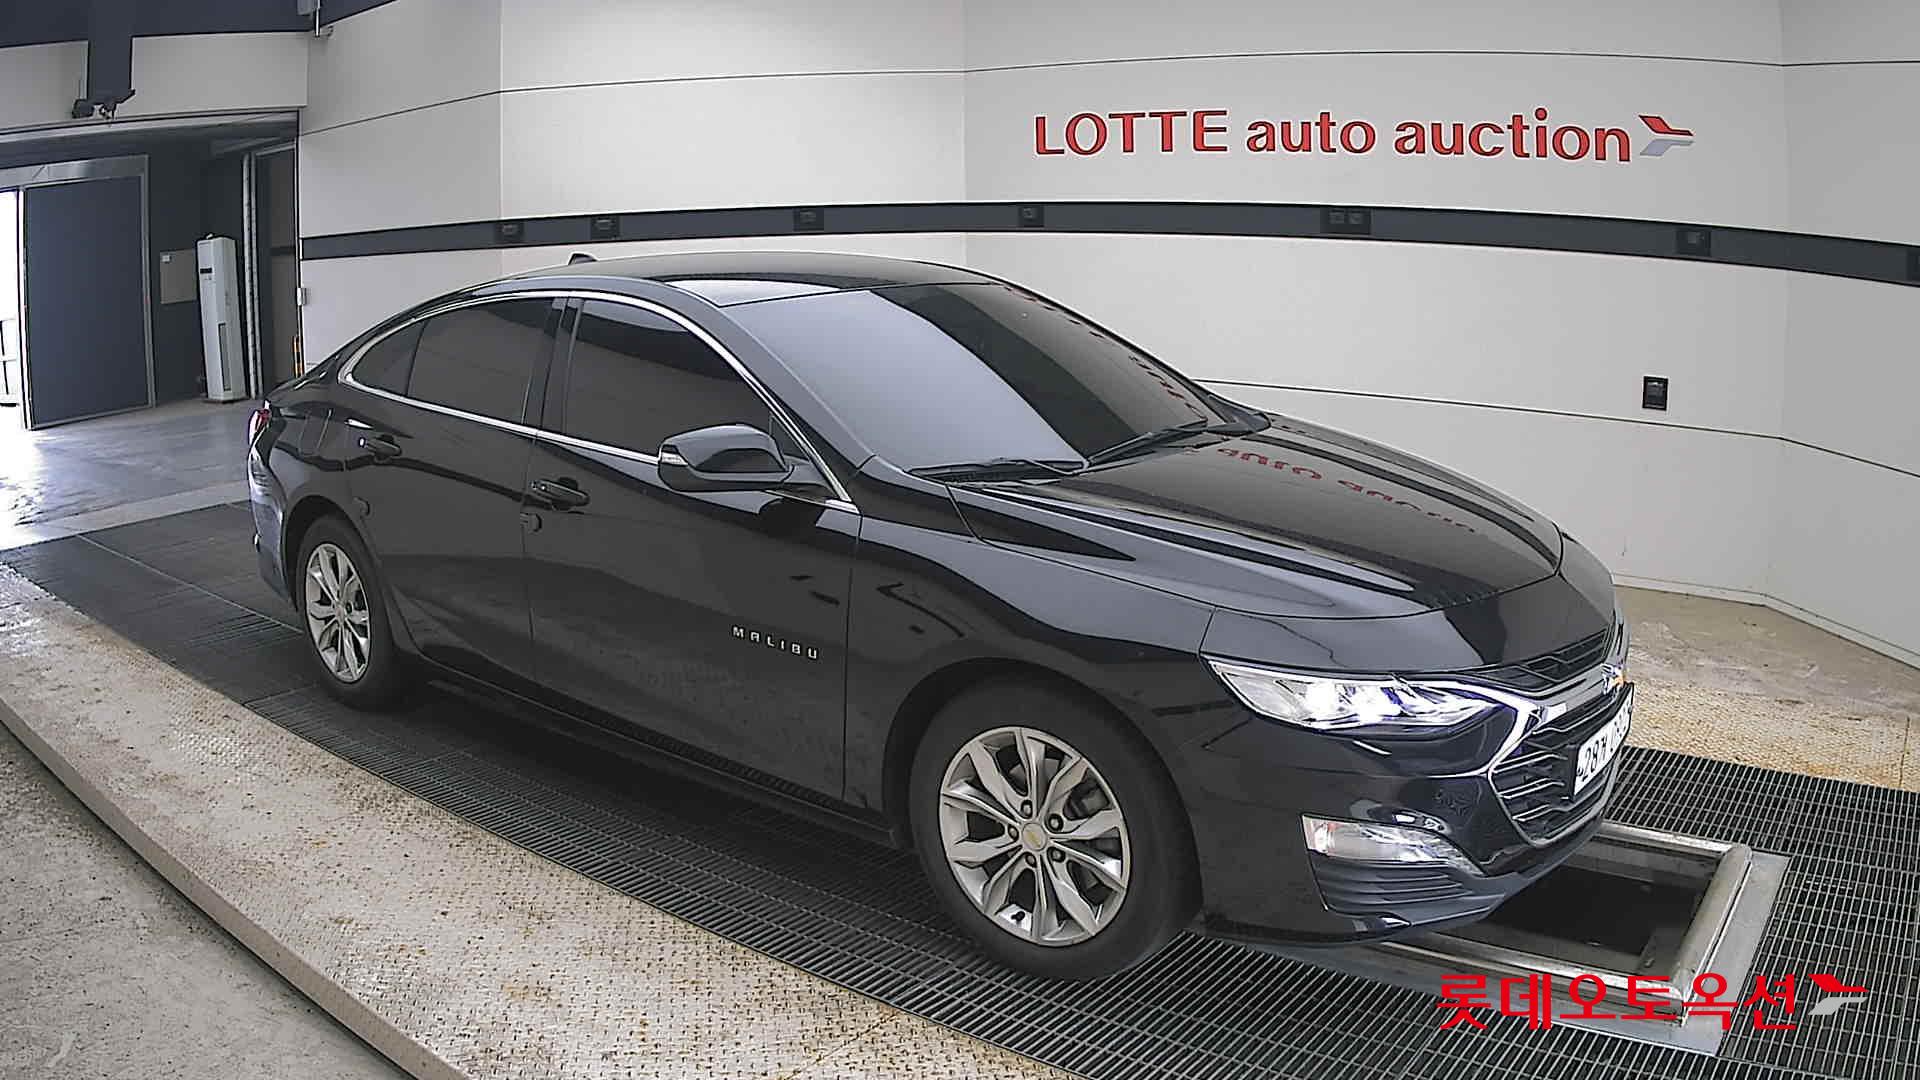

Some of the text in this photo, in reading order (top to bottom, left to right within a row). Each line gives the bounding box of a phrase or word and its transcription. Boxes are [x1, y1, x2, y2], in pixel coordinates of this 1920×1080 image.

[1034, 107, 1632, 163] LOTTE auto auction
[732, 625, 818, 660] MALIBU
